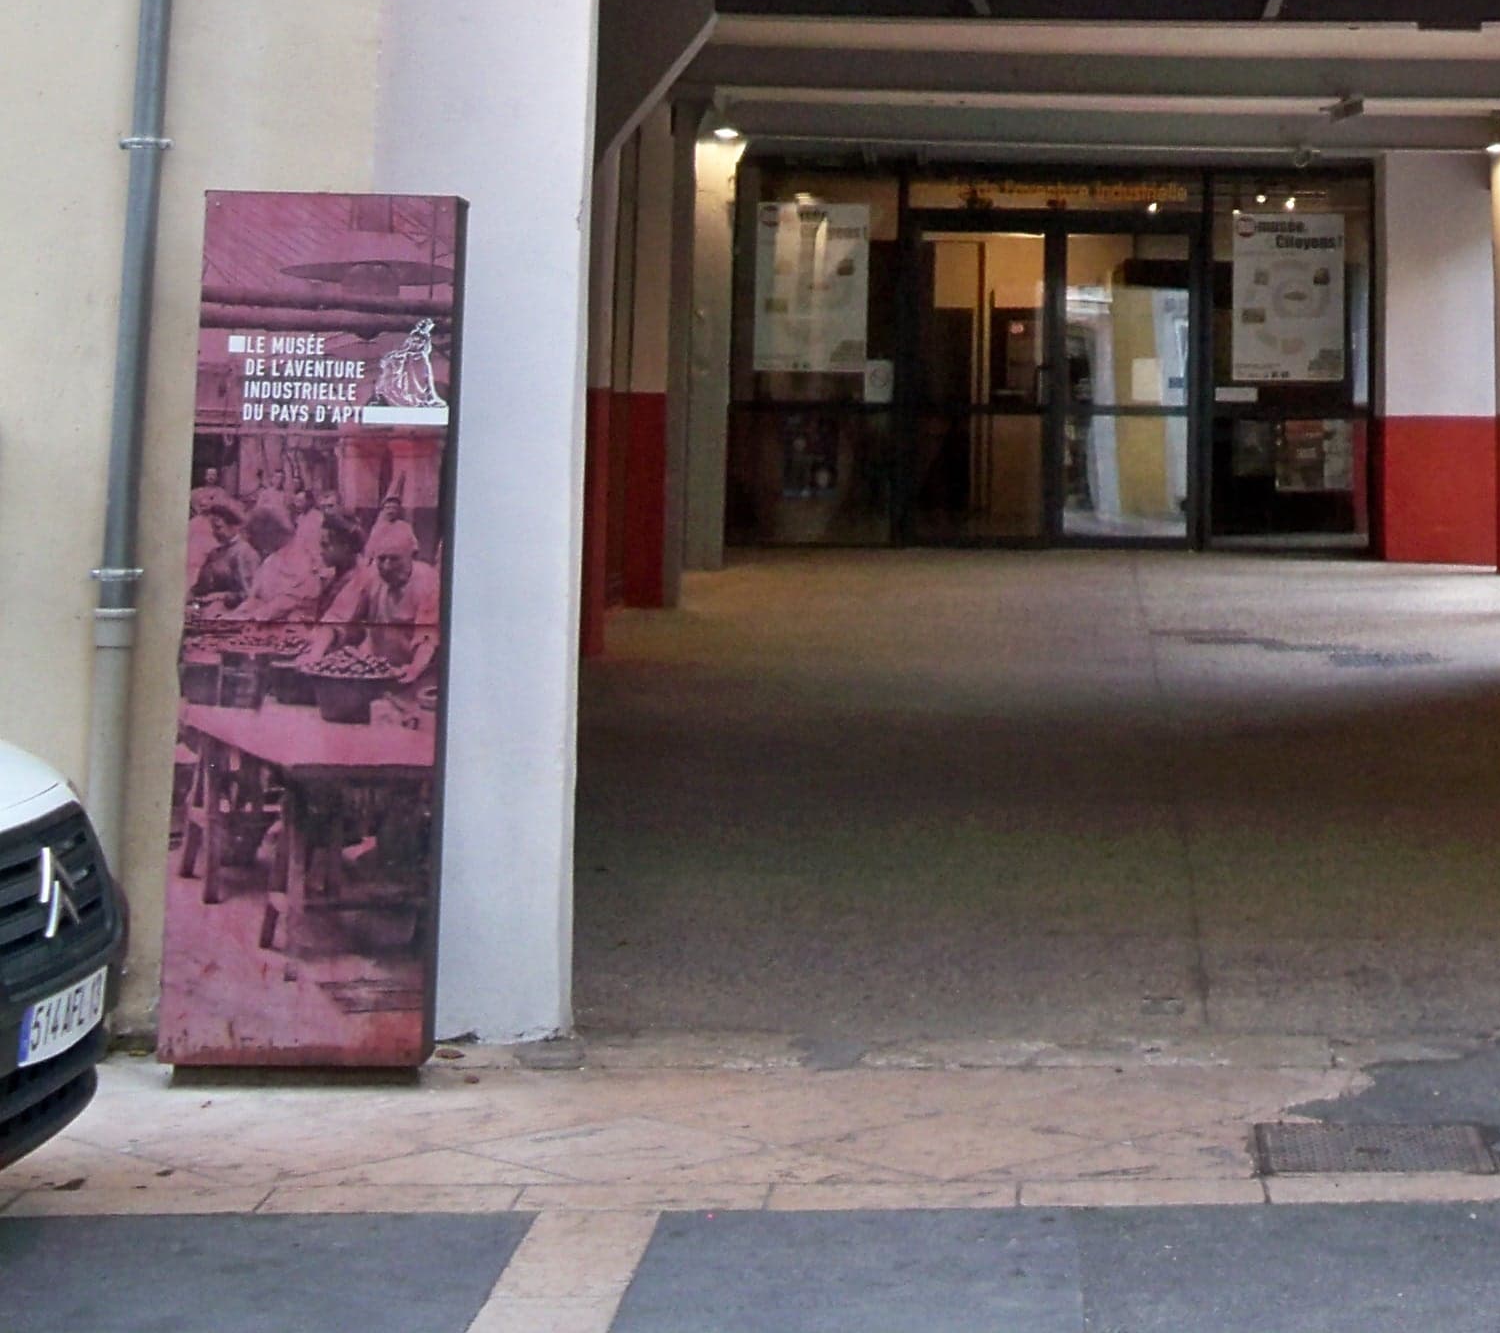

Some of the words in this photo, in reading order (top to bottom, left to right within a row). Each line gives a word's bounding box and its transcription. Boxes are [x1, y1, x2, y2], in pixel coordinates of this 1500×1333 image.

[247, 336, 265, 353] LE
[272, 334, 325, 354] MUSÉE
[245, 358, 264, 377] DE
[271, 359, 366, 379] L'AVENTURE
[244, 381, 356, 401] INDUSTRIELLE
[243, 405, 264, 421] DU
[270, 405, 309, 423] PAYS
[316, 406, 362, 424] D'APT
